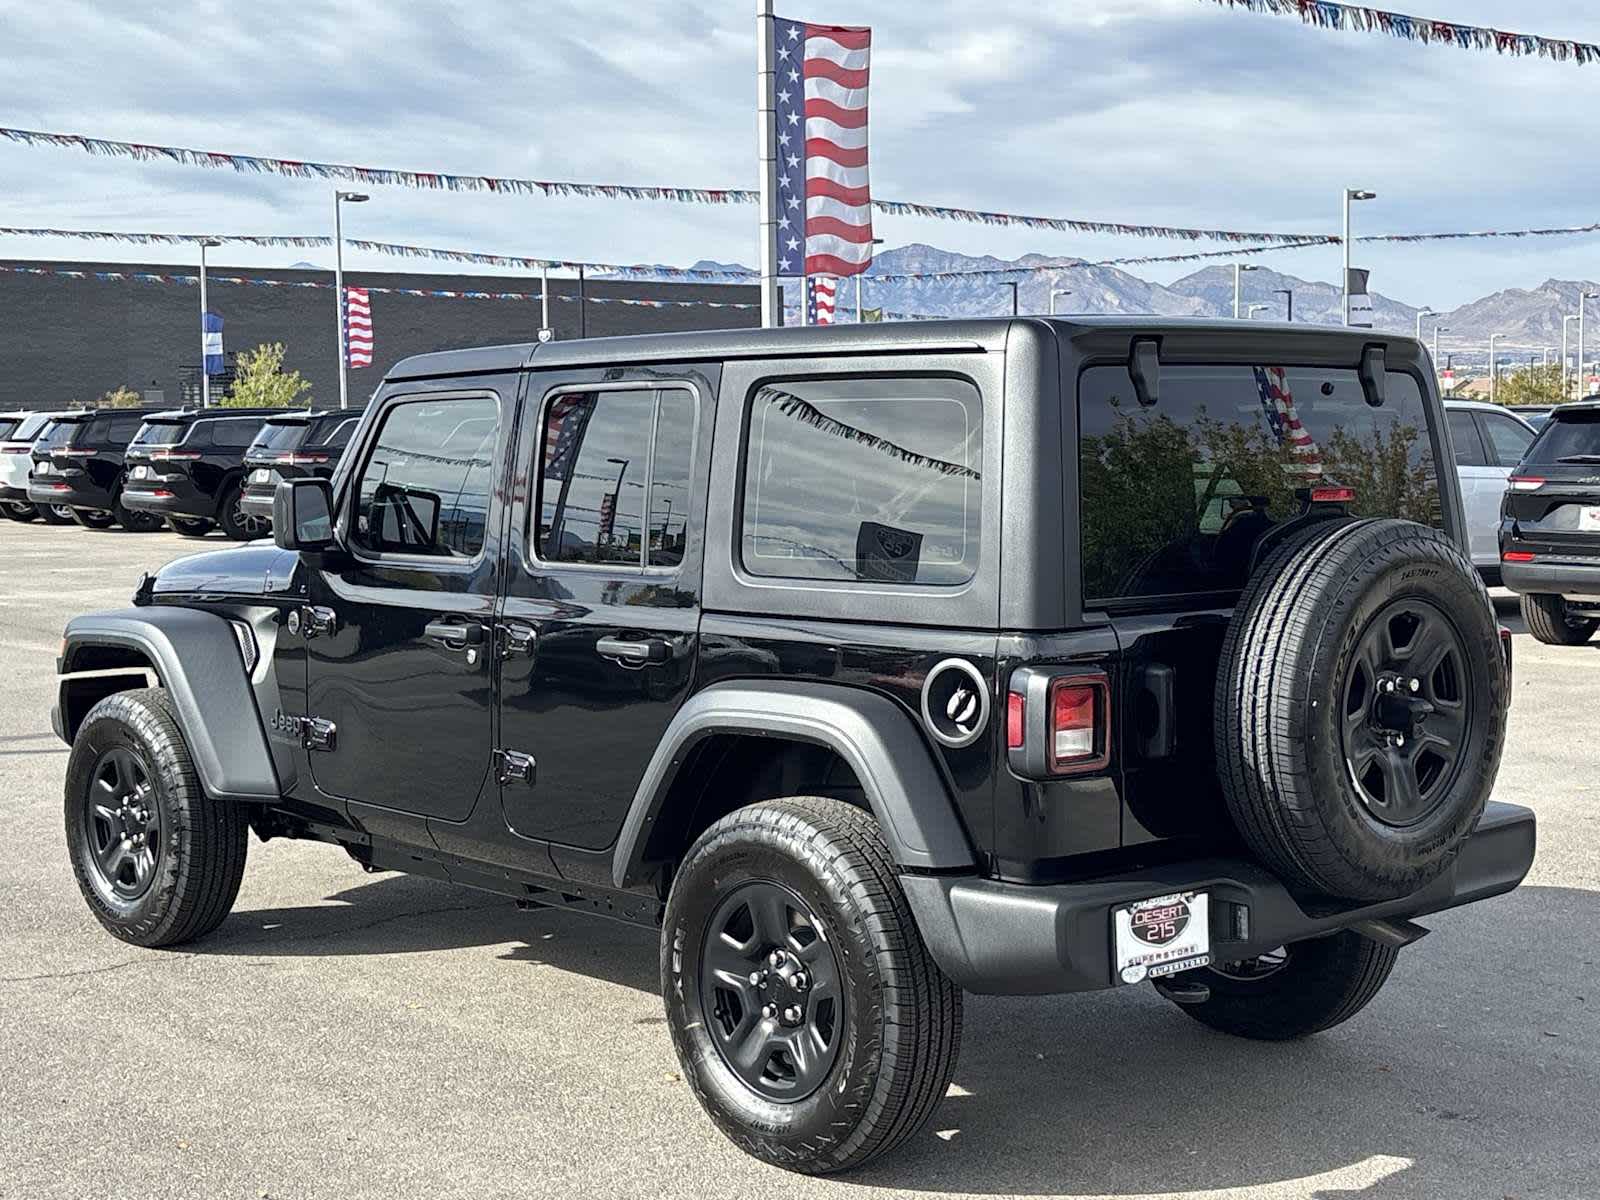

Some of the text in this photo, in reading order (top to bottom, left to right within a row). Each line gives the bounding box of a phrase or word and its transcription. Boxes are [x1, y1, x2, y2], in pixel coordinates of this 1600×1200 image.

[270, 708, 300, 727] Jeep
[1134, 904, 1185, 925] DESERT
[1147, 921, 1176, 940] 215
[1127, 946, 1195, 966] SUPERSTORE
